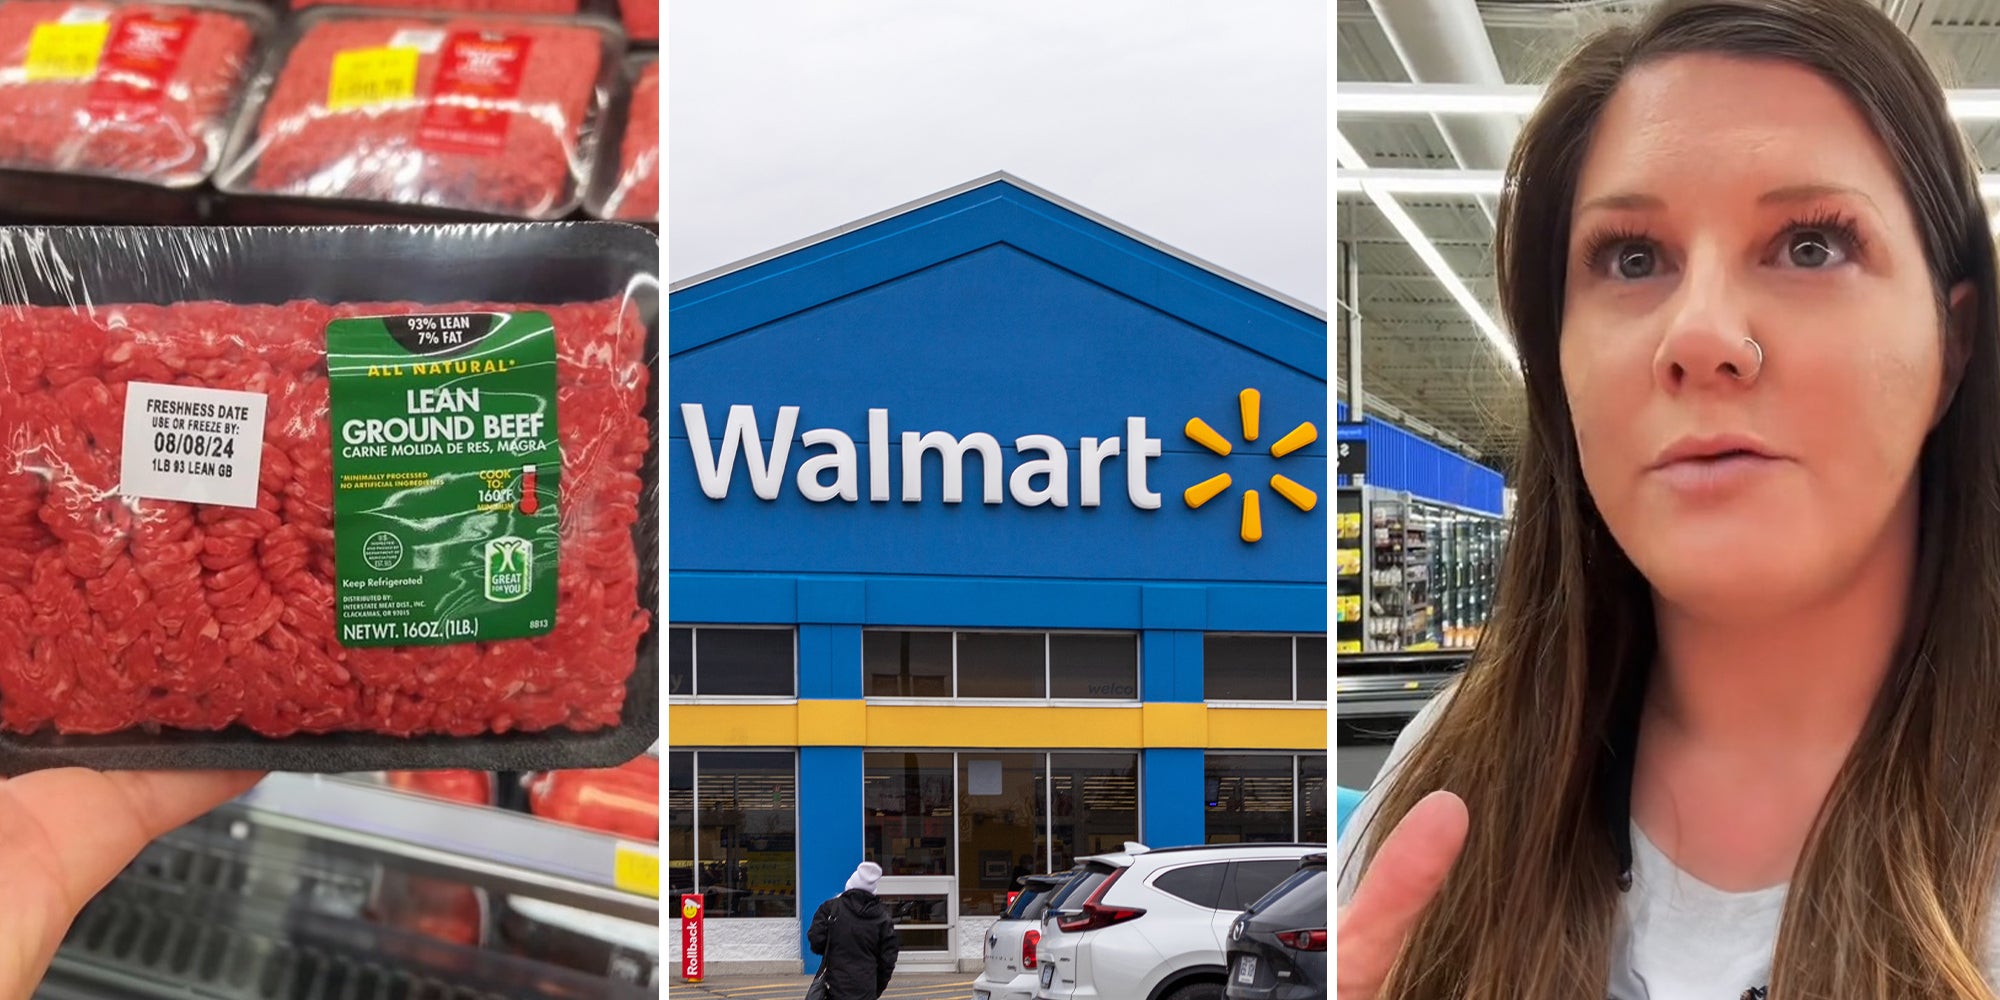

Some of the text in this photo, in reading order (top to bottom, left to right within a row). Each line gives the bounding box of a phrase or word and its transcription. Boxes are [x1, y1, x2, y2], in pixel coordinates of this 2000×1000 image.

[407, 316, 470, 331] 93% LEAN
[418, 330, 463, 345] 7% FAT
[367, 365, 403, 377] ALL
[407, 387, 480, 414] LEAN
[146, 398, 249, 421] FRESHNESS DATE
[152, 416, 240, 435] USE OR FREEZE BY:
[341, 413, 545, 446] GROUND BEEF
[154, 432, 234, 459] 08/08/24
[342, 439, 547, 459] CARNE MOLIDA DE RES, MAGRA
[681, 402, 1162, 510] Walmart
[152, 458, 233, 478] 1LB 93 LEAN GB
[386, 471, 428, 480] PROCESSED
[480, 469, 511, 480] COOK
[354, 481, 393, 489] ARTIFICIAL
[486, 479, 504, 489] TO:
[342, 575, 423, 590] Keep Refrigerated
[492, 573, 522, 585] GREAT
[503, 584, 521, 594] YOU
[343, 595, 382, 603] DISTRIBUTED
[343, 602, 378, 610] INTERSTATE
[378, 601, 395, 609] MEAT
[445, 617, 479, 639] (1LB.)
[686, 920, 698, 976] Rollback
